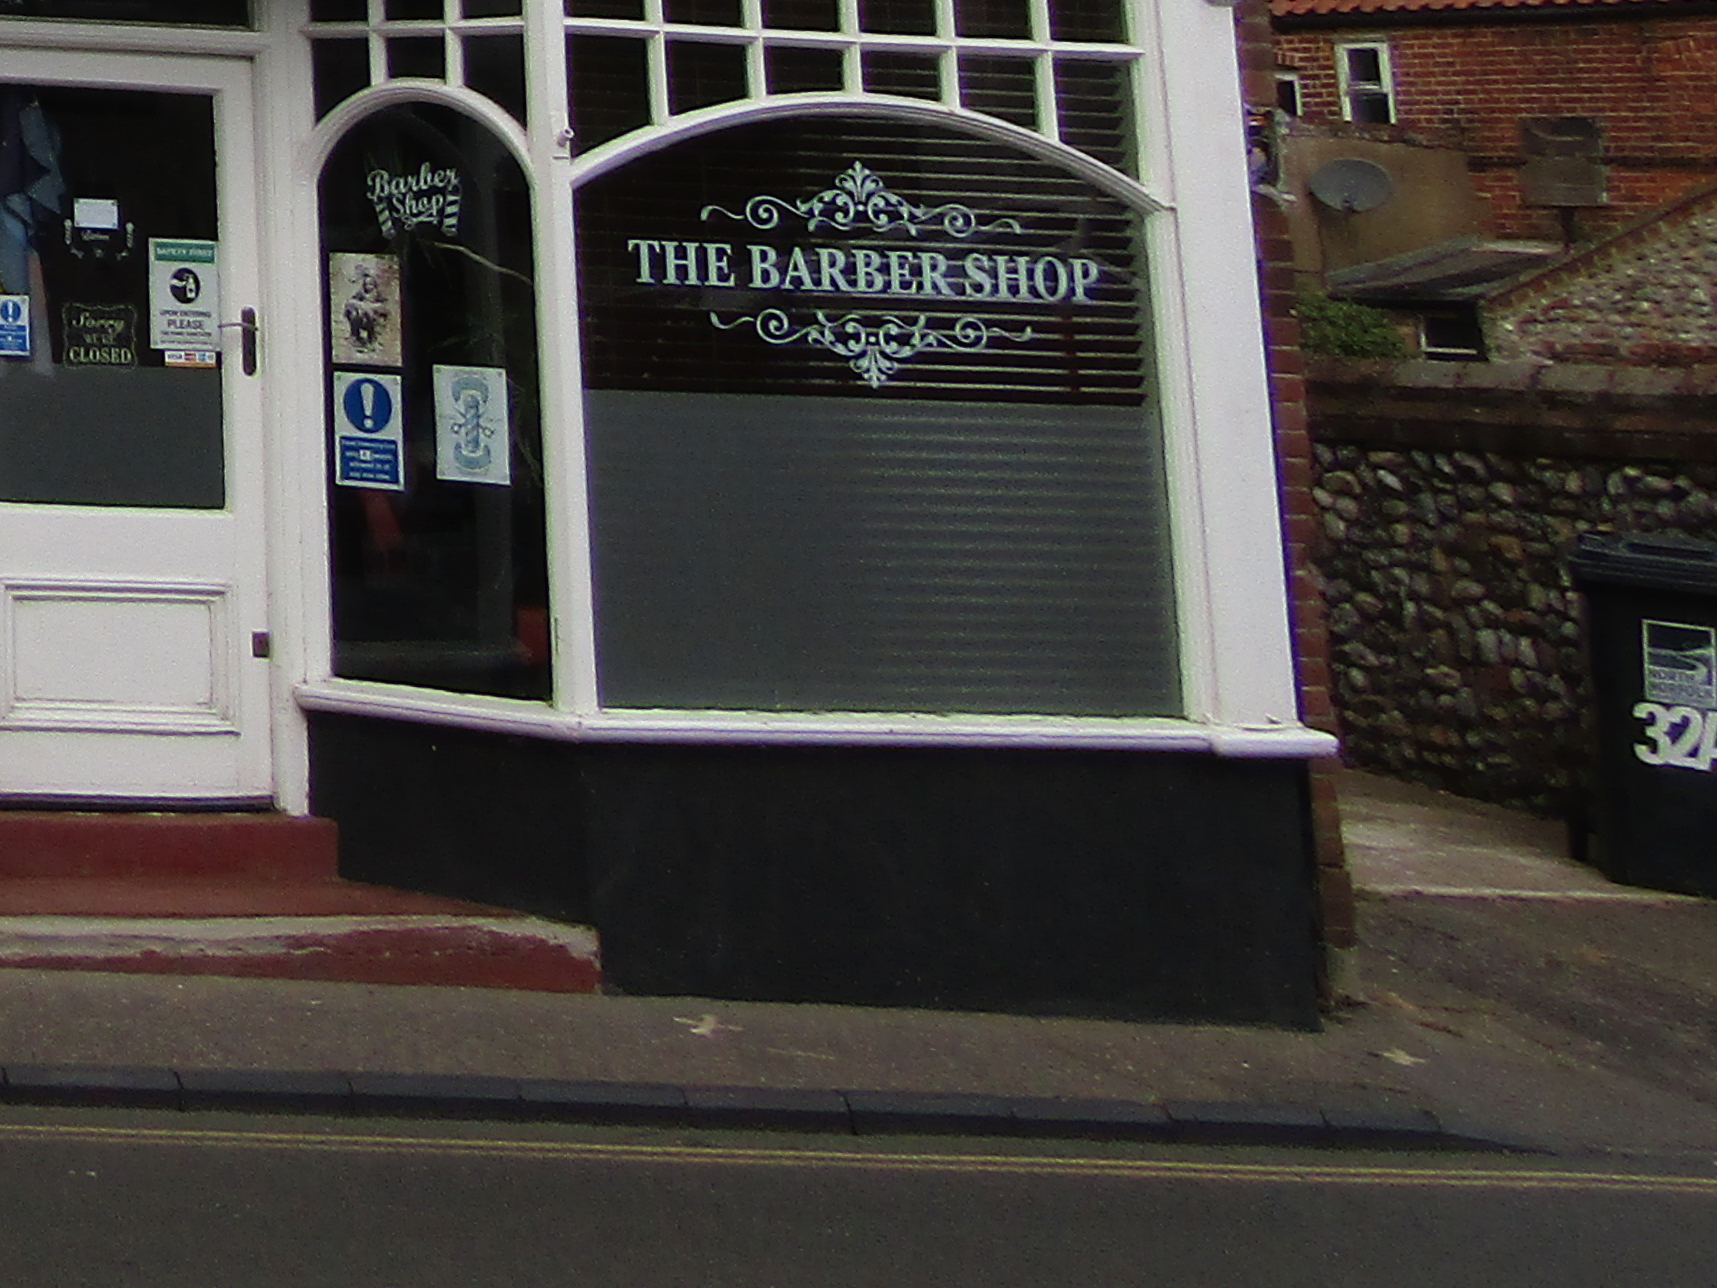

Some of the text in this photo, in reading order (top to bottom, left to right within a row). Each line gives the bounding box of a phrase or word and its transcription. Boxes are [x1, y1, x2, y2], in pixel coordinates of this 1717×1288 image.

[366, 162, 461, 202] Barber
[391, 191, 444, 219] Shop
[626, 238, 1101, 303] THE BARBER SHOP
[71, 312, 126, 336] Sorry
[167, 319, 205, 330] PLEASE
[69, 346, 132, 364] CLOSED
